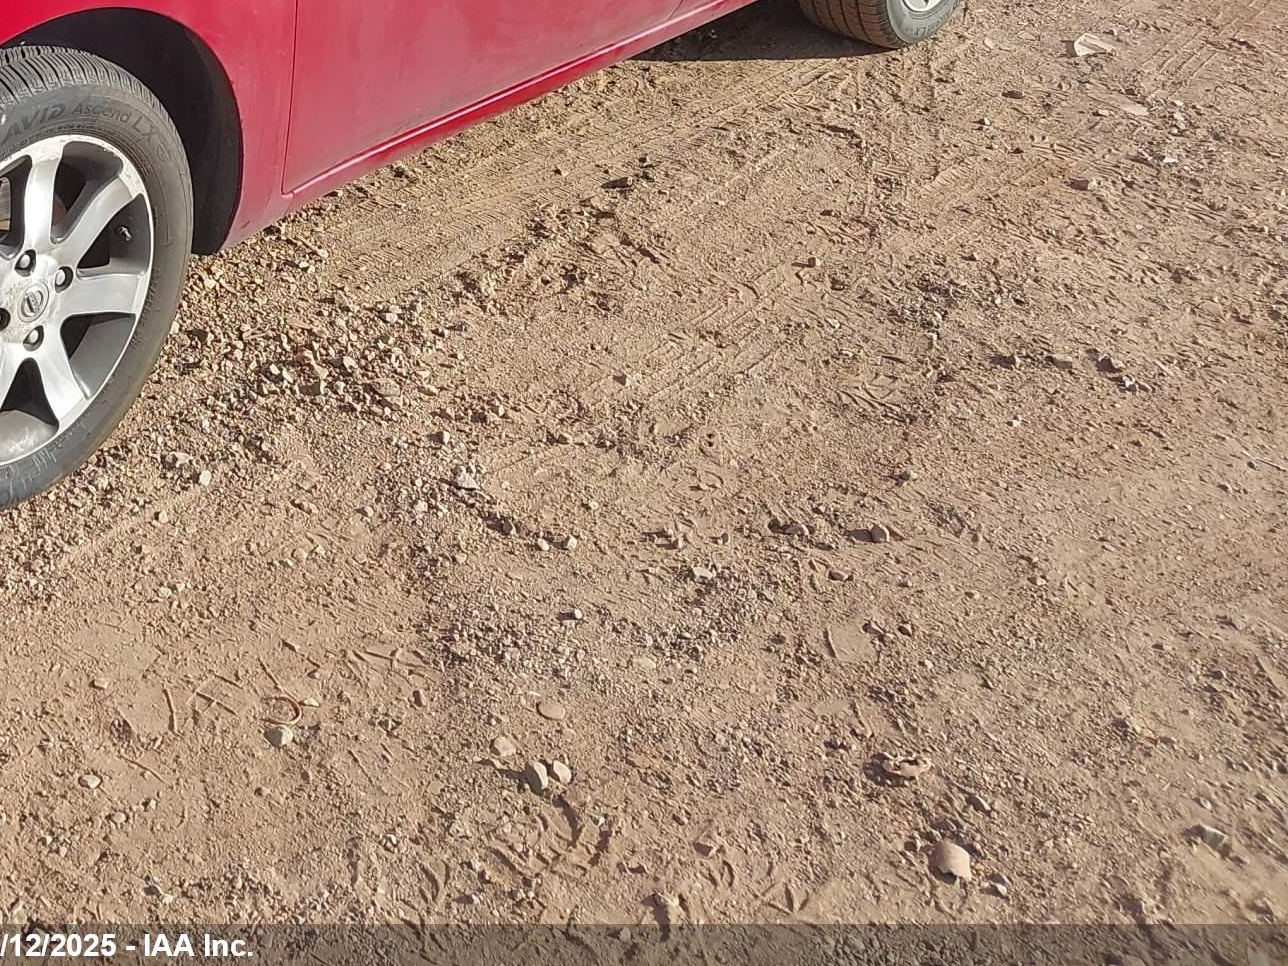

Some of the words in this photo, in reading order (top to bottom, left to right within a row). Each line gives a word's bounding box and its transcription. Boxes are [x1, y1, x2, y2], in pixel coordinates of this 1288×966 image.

[0, 105, 66, 146] AVID
[72, 103, 132, 124] Ascend
[131, 117, 156, 144] LX
